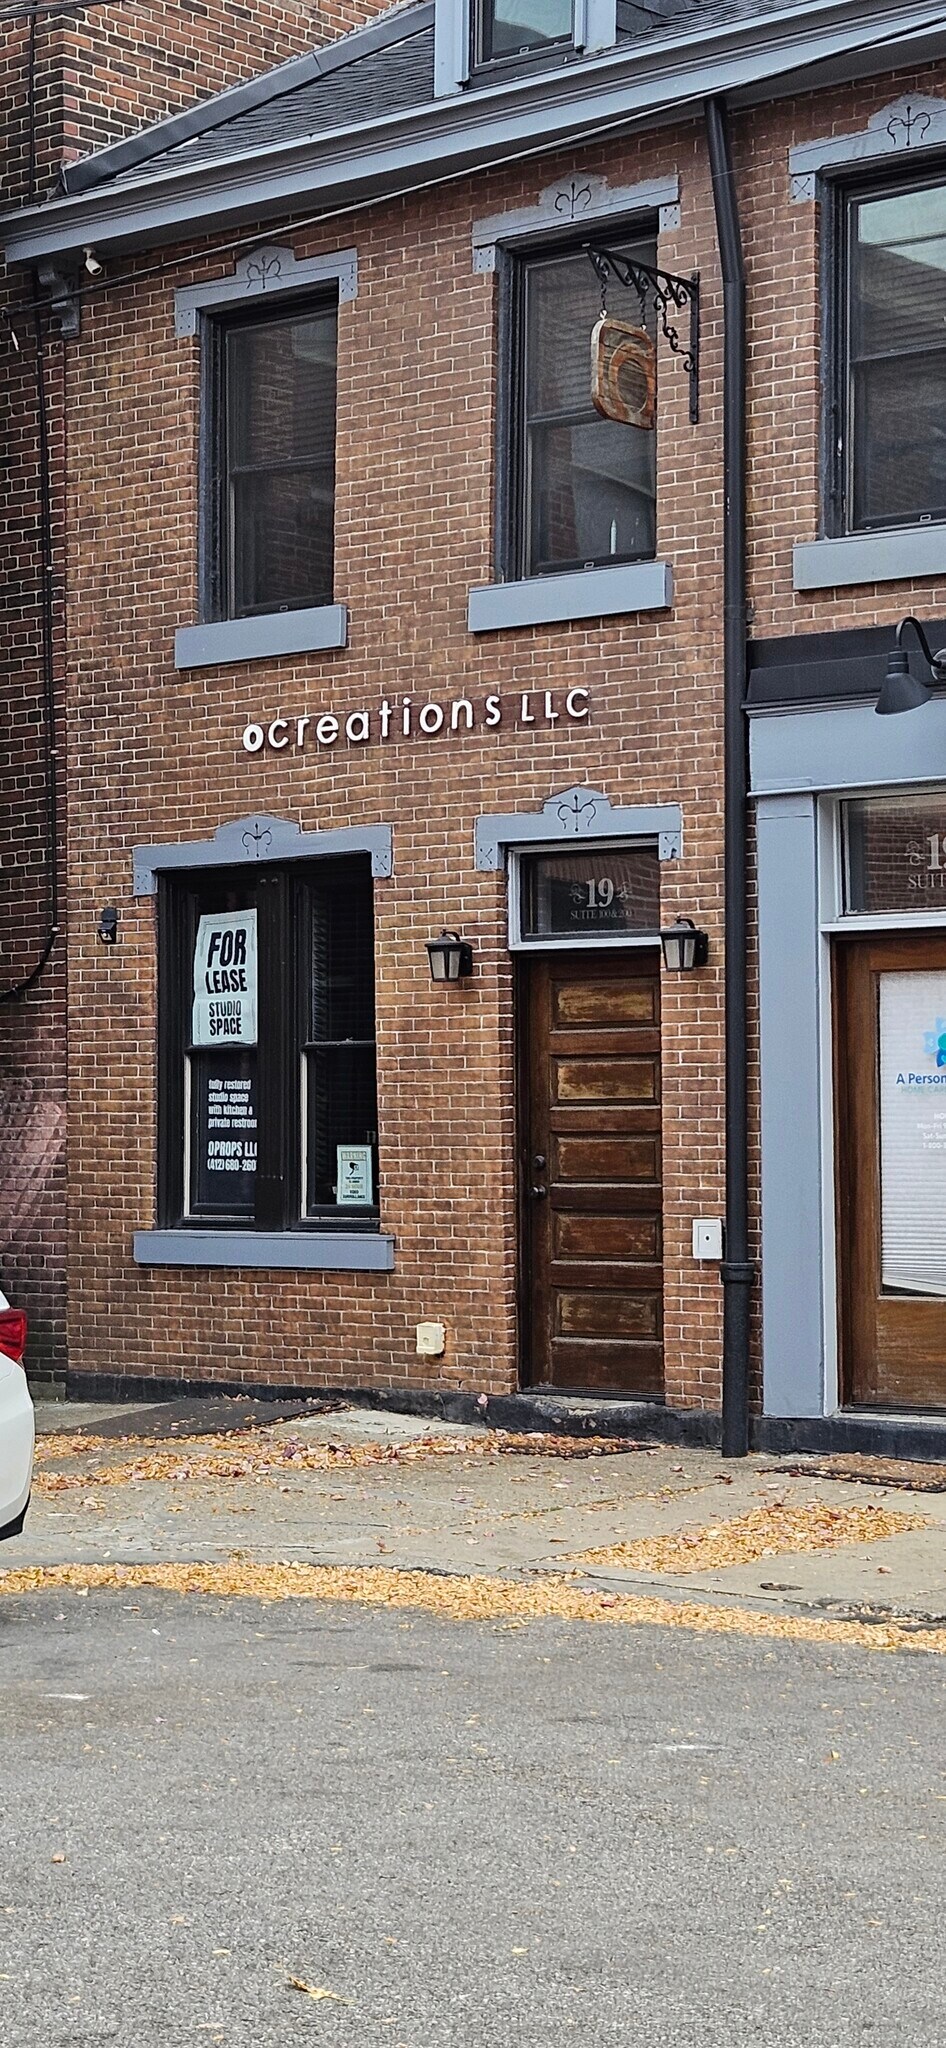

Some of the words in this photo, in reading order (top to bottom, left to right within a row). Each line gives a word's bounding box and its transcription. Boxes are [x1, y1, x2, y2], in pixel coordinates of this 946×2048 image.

[242, 695, 502, 752] ocreations
[521, 688, 590, 722] LLC
[926, 833, 946, 870] 1
[586, 878, 614, 907] 19
[570, 909, 597, 919] SUITE
[207, 928, 247, 968] FOR
[205, 968, 248, 994] LEASE
[208, 1000, 242, 1018] STUDIO
[209, 1017, 242, 1036] SPACE
[208, 1079, 223, 1091] fully
[224, 1079, 251, 1090] restored
[896, 1073, 906, 1085] A
[208, 1092, 228, 1102] studio
[229, 1093, 249, 1104] space
[208, 1104, 222, 1115] with
[223, 1104, 248, 1115] kitchen
[208, 1116, 230, 1129] private
[208, 1140, 243, 1157] OPROPS
[207, 1158, 225, 1170] (412)
